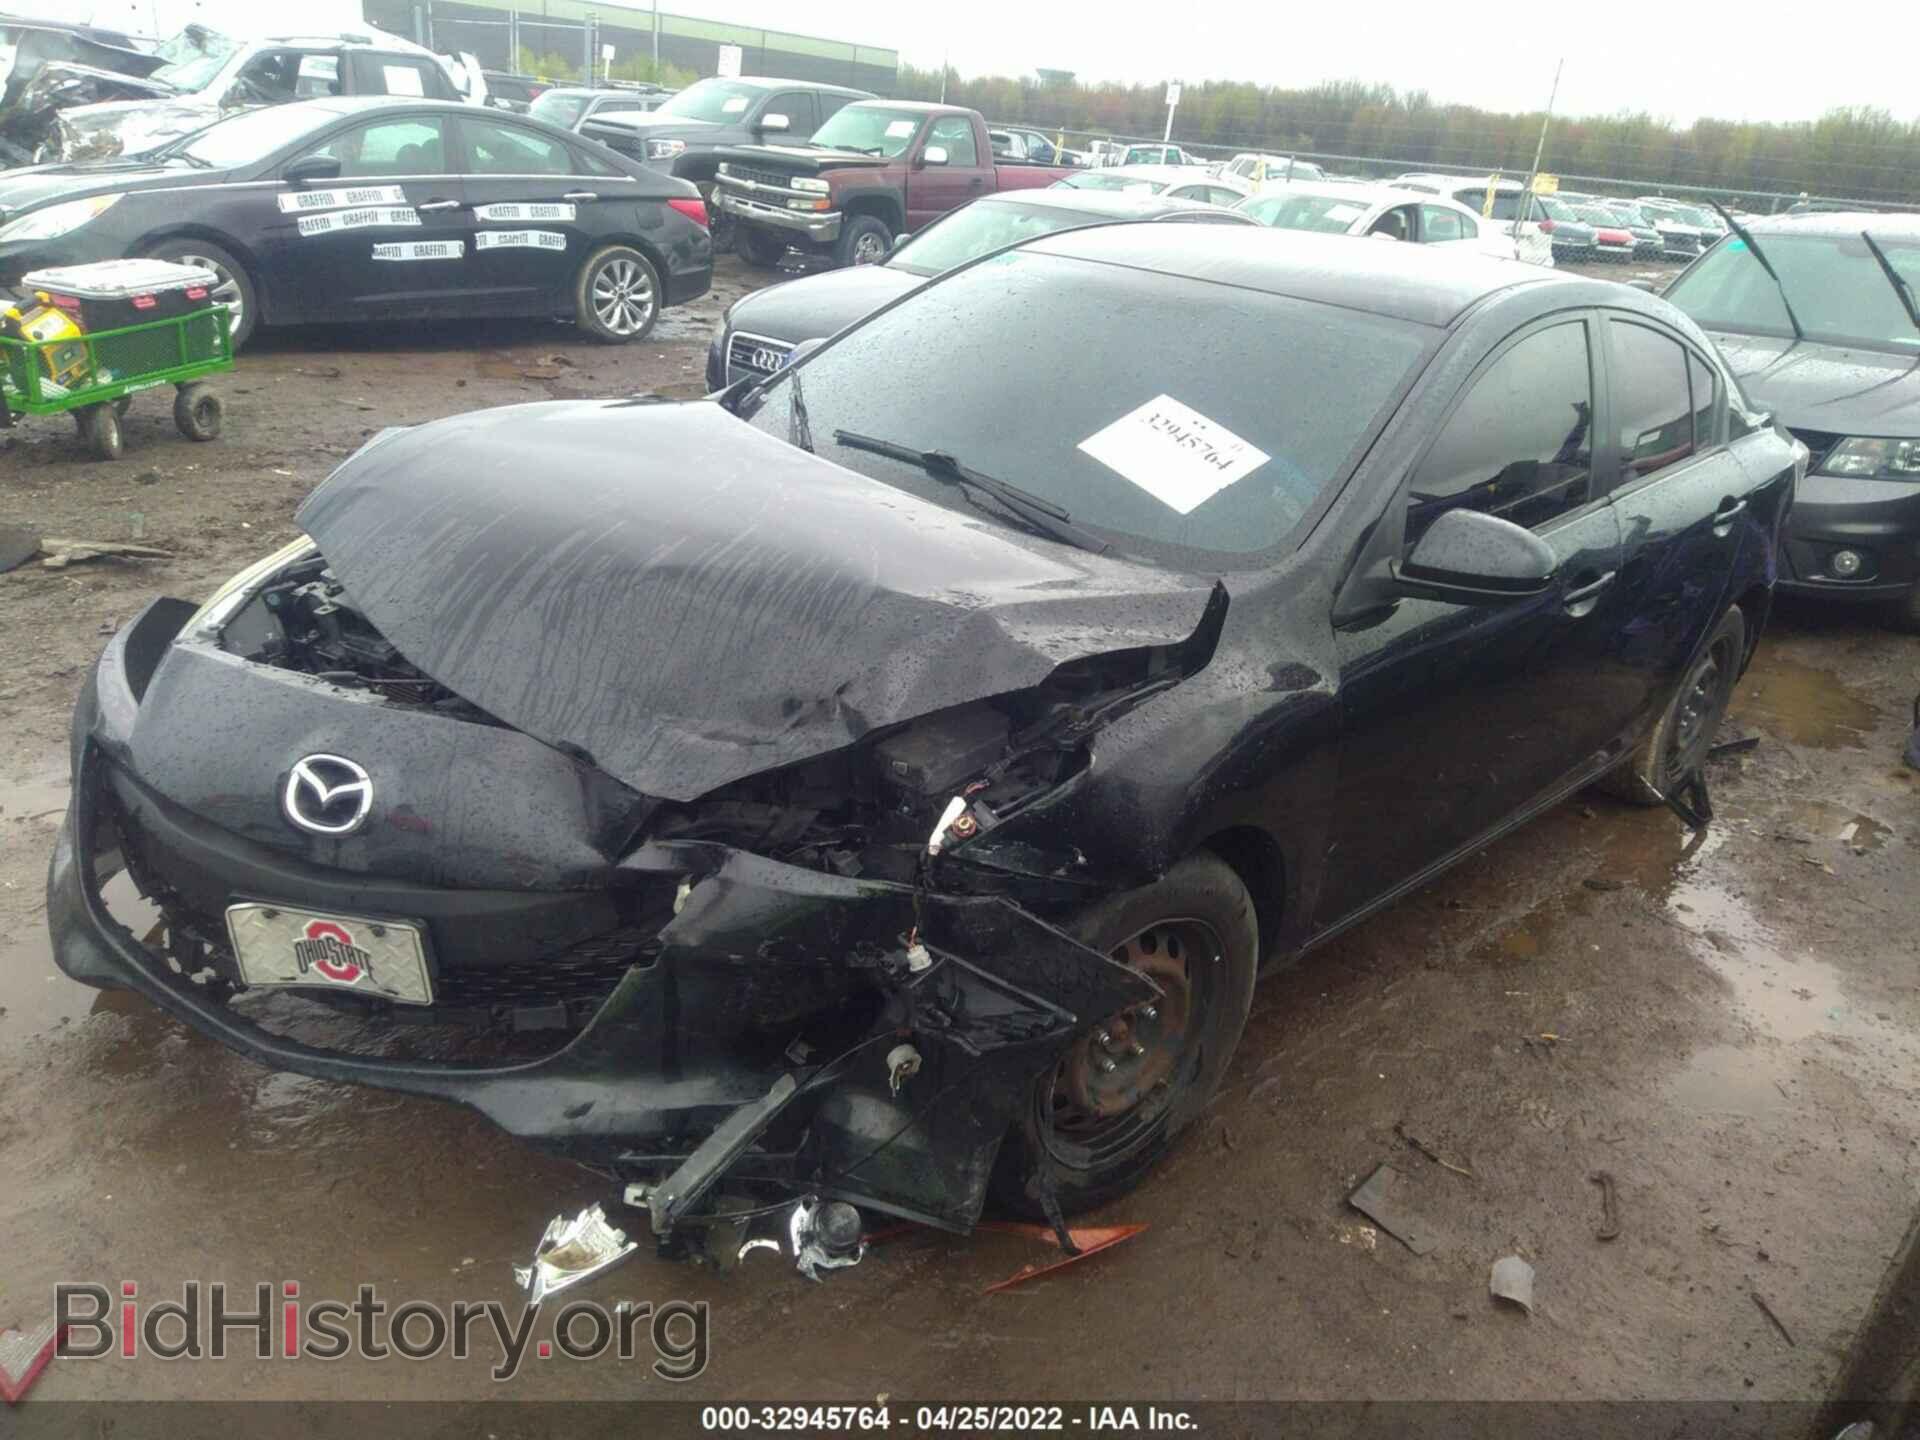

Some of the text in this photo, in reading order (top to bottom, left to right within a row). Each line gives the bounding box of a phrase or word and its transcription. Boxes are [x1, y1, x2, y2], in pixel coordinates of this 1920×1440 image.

[342, 210, 379, 226] GRAFFITI
[488, 205, 520, 218] GRAFFITI
[529, 205, 560, 218] GRAFFITI
[497, 231, 528, 245] GRAFFITI
[413, 243, 447, 257] GRAFFITI
